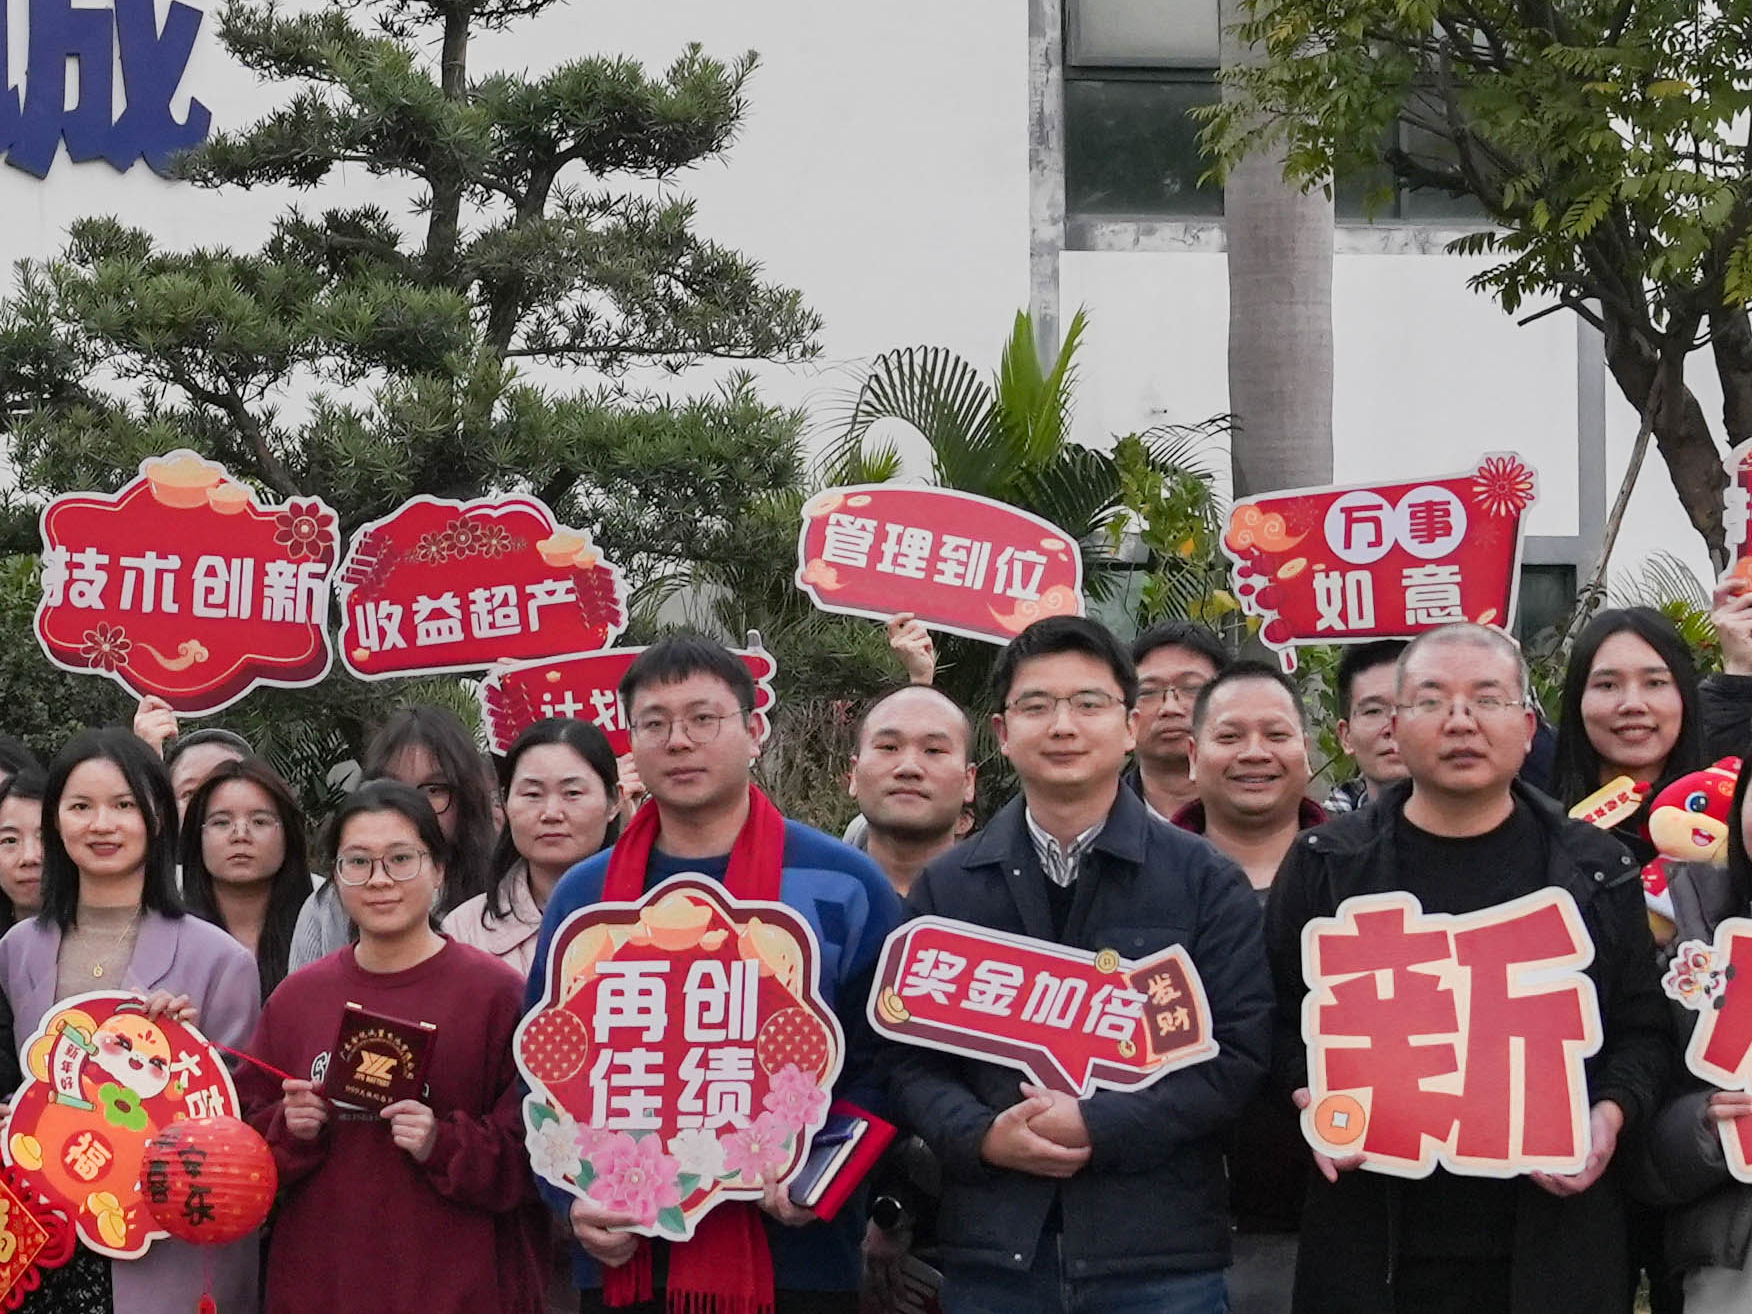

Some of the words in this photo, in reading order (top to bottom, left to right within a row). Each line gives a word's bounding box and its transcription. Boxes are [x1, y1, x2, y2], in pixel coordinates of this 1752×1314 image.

[820, 511, 1049, 604] 管理到位
[1337, 499, 1456, 547] 万事
[41, 544, 328, 626] 技术创新
[354, 577, 582, 653] 收益超产
[1311, 562, 1468, 632] 如意
[593, 958, 759, 1044] 再创
[900, 947, 1147, 1041] 奖金加倍
[1147, 972, 1190, 1037] 发财
[1316, 902, 1588, 1161] 新
[58, 1042, 81, 1091] 新年好
[589, 1045, 756, 1131] 佳绩
